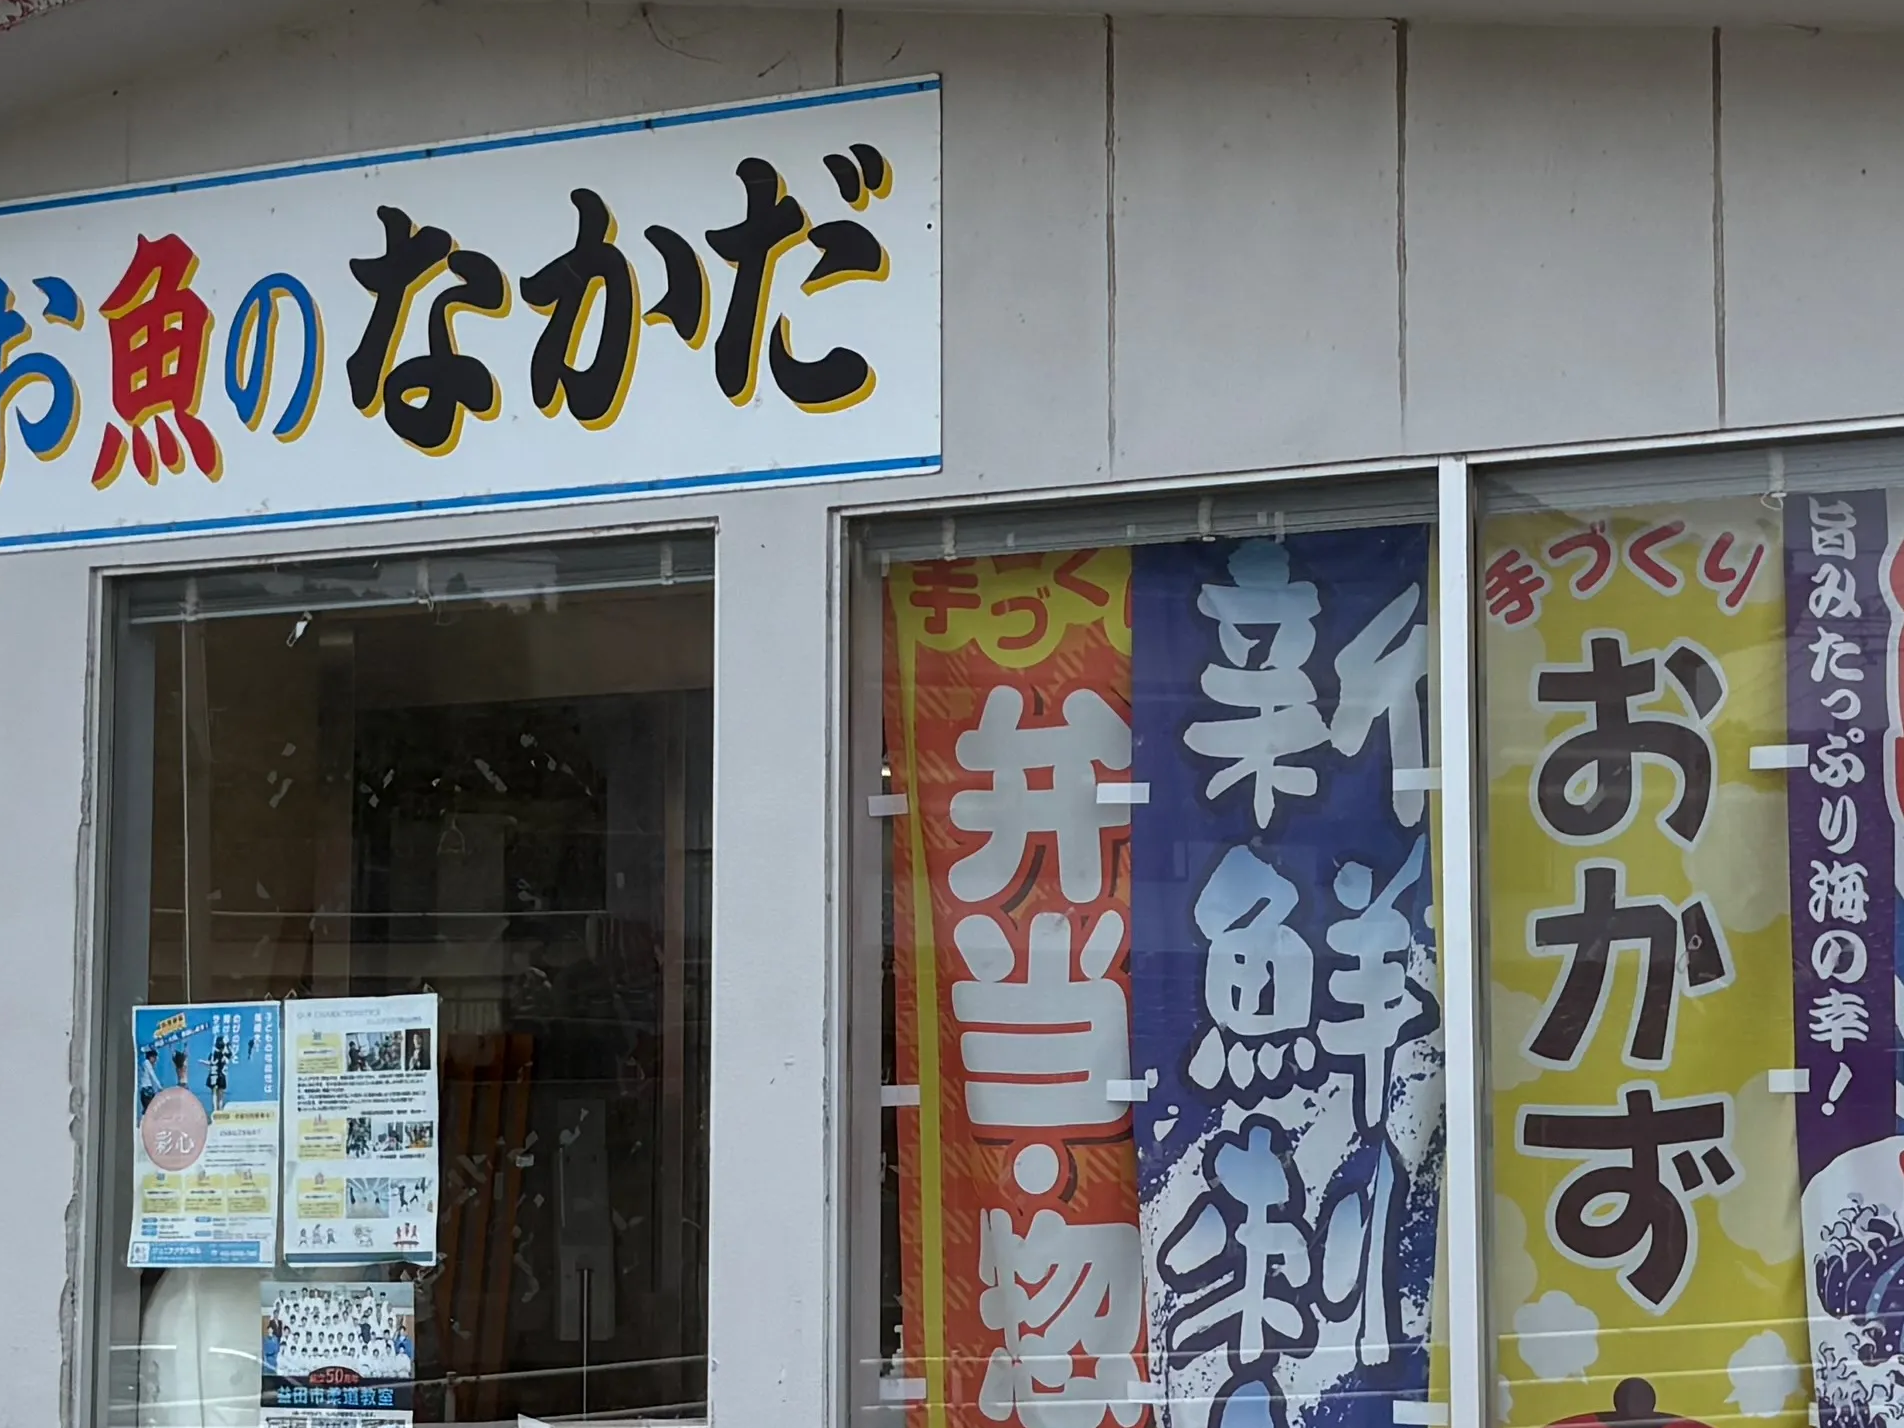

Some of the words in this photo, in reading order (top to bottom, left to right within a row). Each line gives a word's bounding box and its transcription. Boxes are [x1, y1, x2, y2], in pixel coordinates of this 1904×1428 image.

[909, 549, 1132, 651] 手づく
[1486, 520, 1764, 625] 手づくり
[1525, 636, 1728, 1307] おかず
